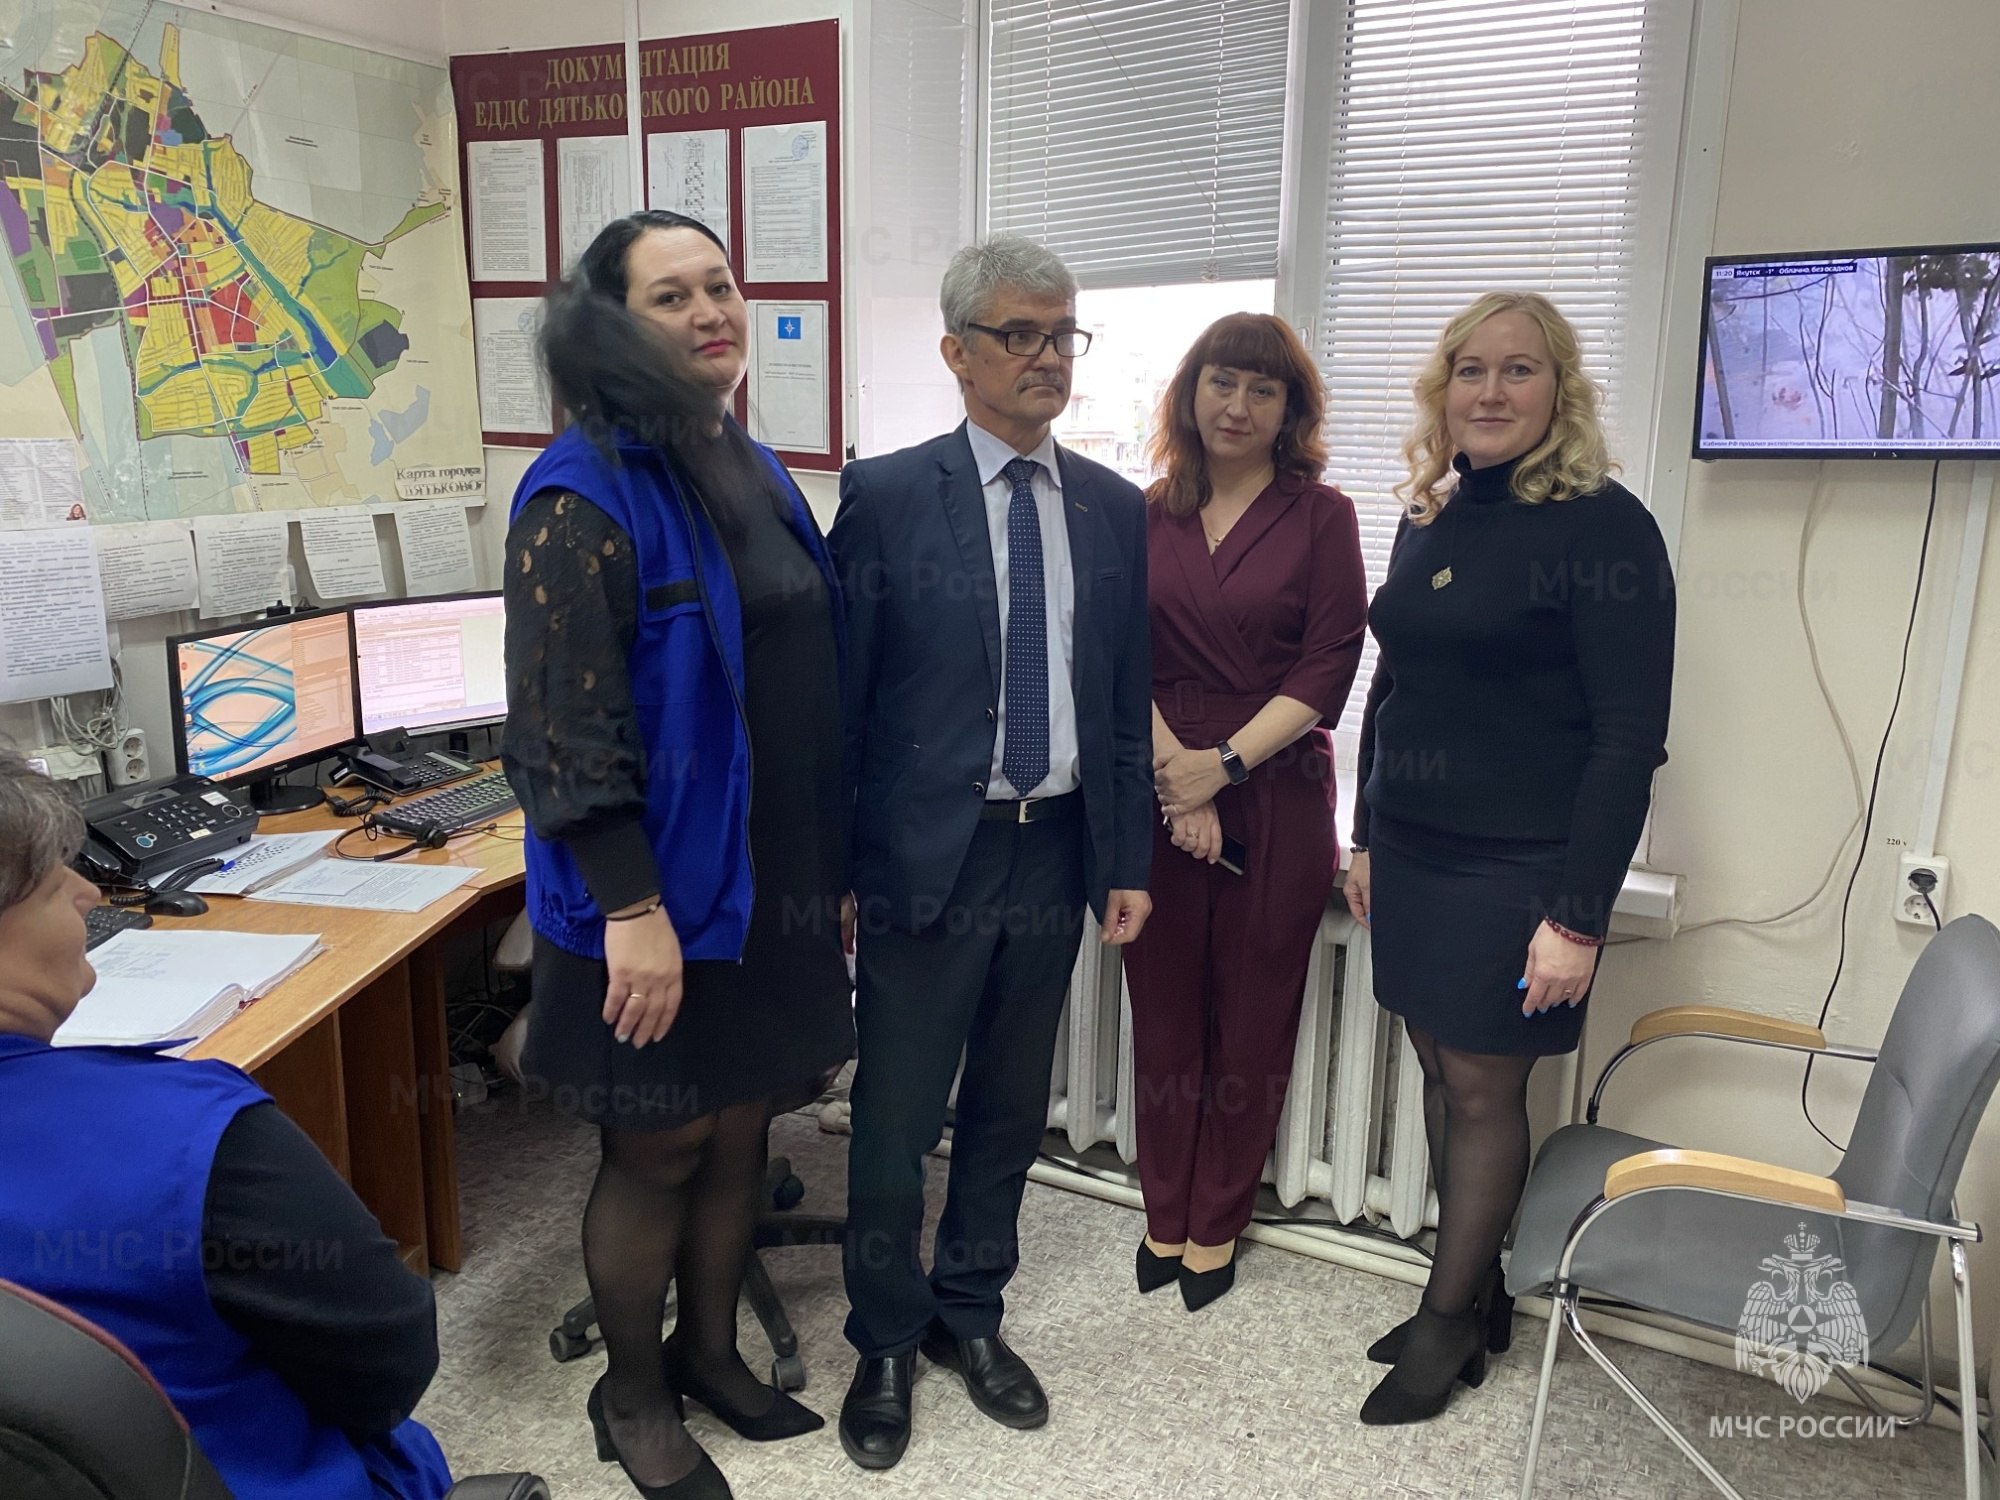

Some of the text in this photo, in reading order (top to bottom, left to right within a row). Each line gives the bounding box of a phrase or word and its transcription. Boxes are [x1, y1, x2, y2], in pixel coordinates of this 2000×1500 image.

[545, 42, 730, 91] ДОКУМНТАЦИЯ
[475, 75, 815, 131] ЕДДС ДЯТЬКОСКОГО РАЙОНА
[1736, 269, 1761, 278] Якутск
[1811, 265, 1824, 273] без
[397, 467, 435, 481] Карта
